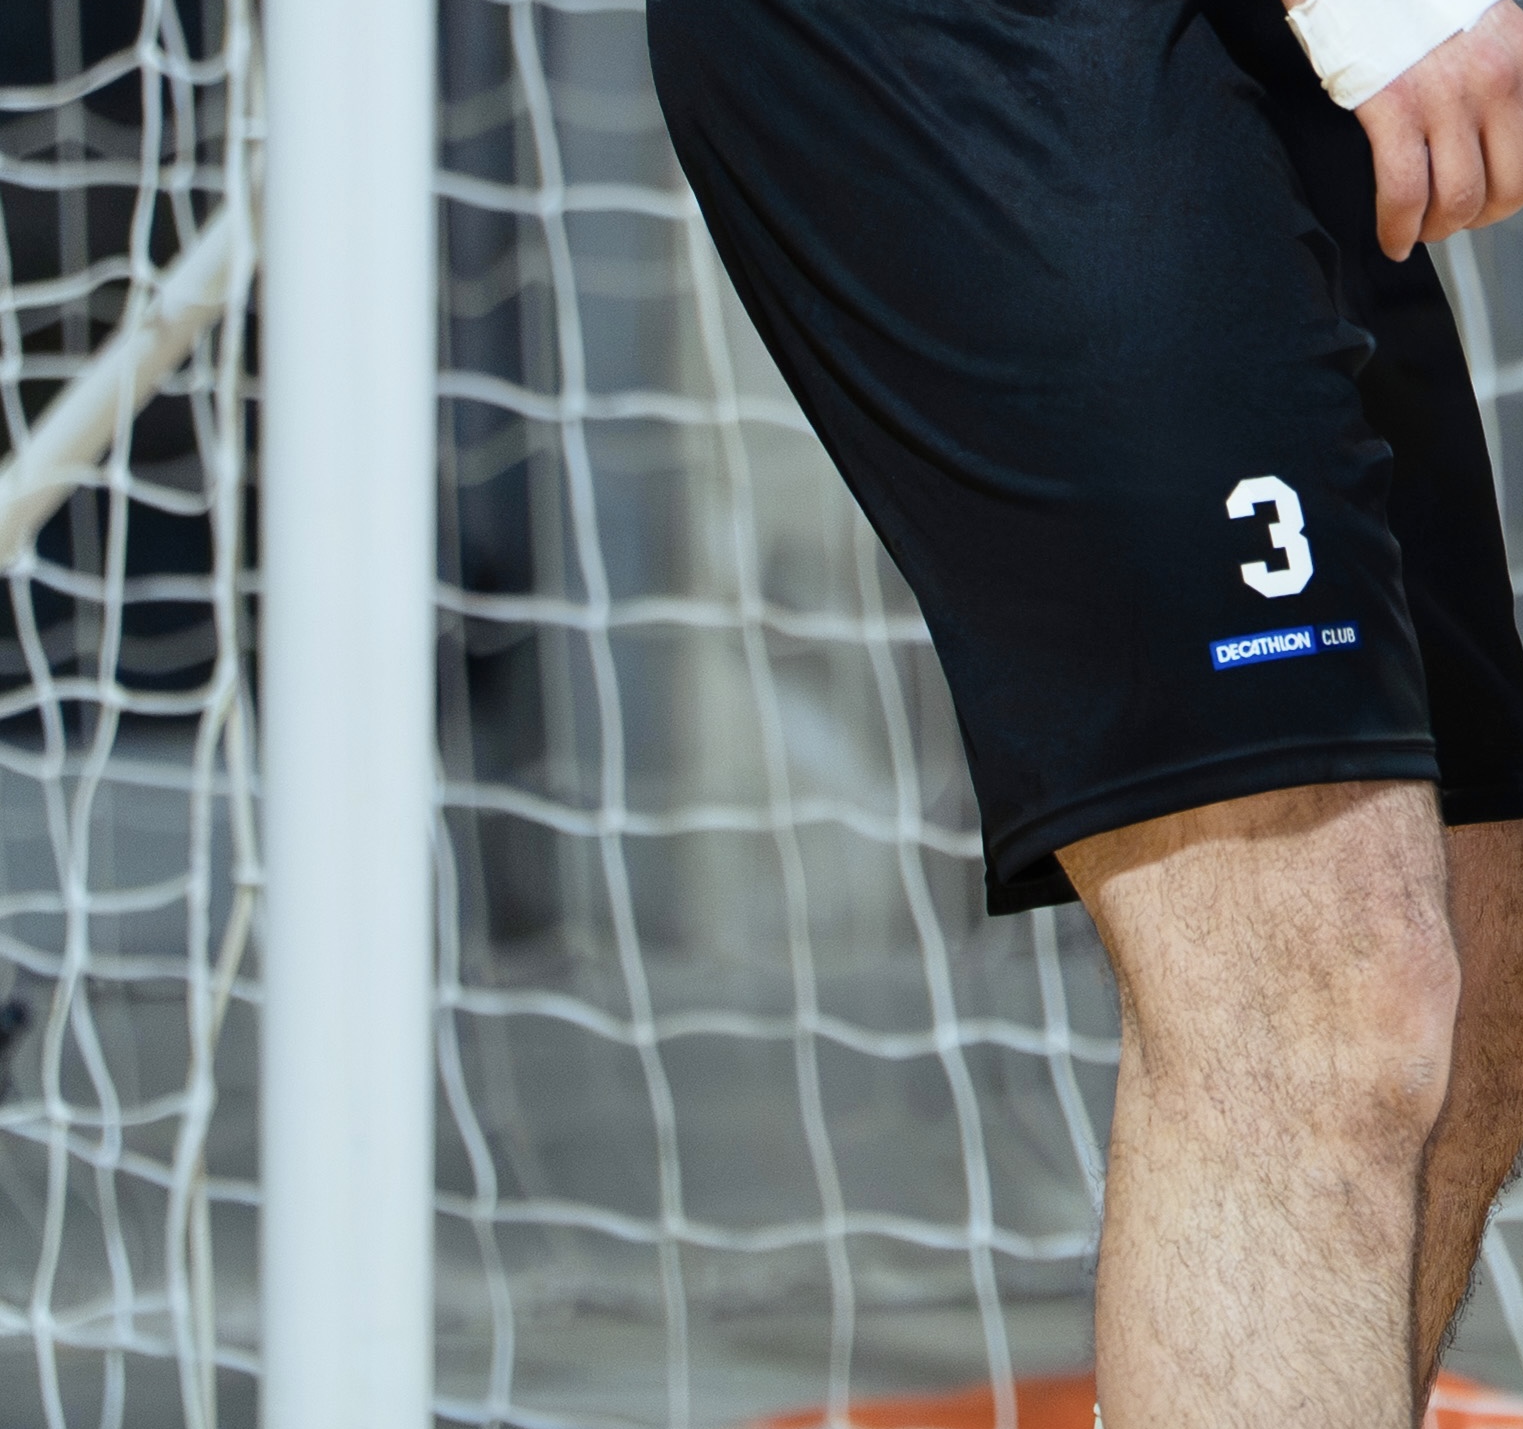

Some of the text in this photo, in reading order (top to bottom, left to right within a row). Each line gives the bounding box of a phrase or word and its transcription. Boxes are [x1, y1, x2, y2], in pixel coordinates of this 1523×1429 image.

[1226, 475, 1314, 599] 3
[1216, 627, 1356, 664] DECATHLON CLUB
